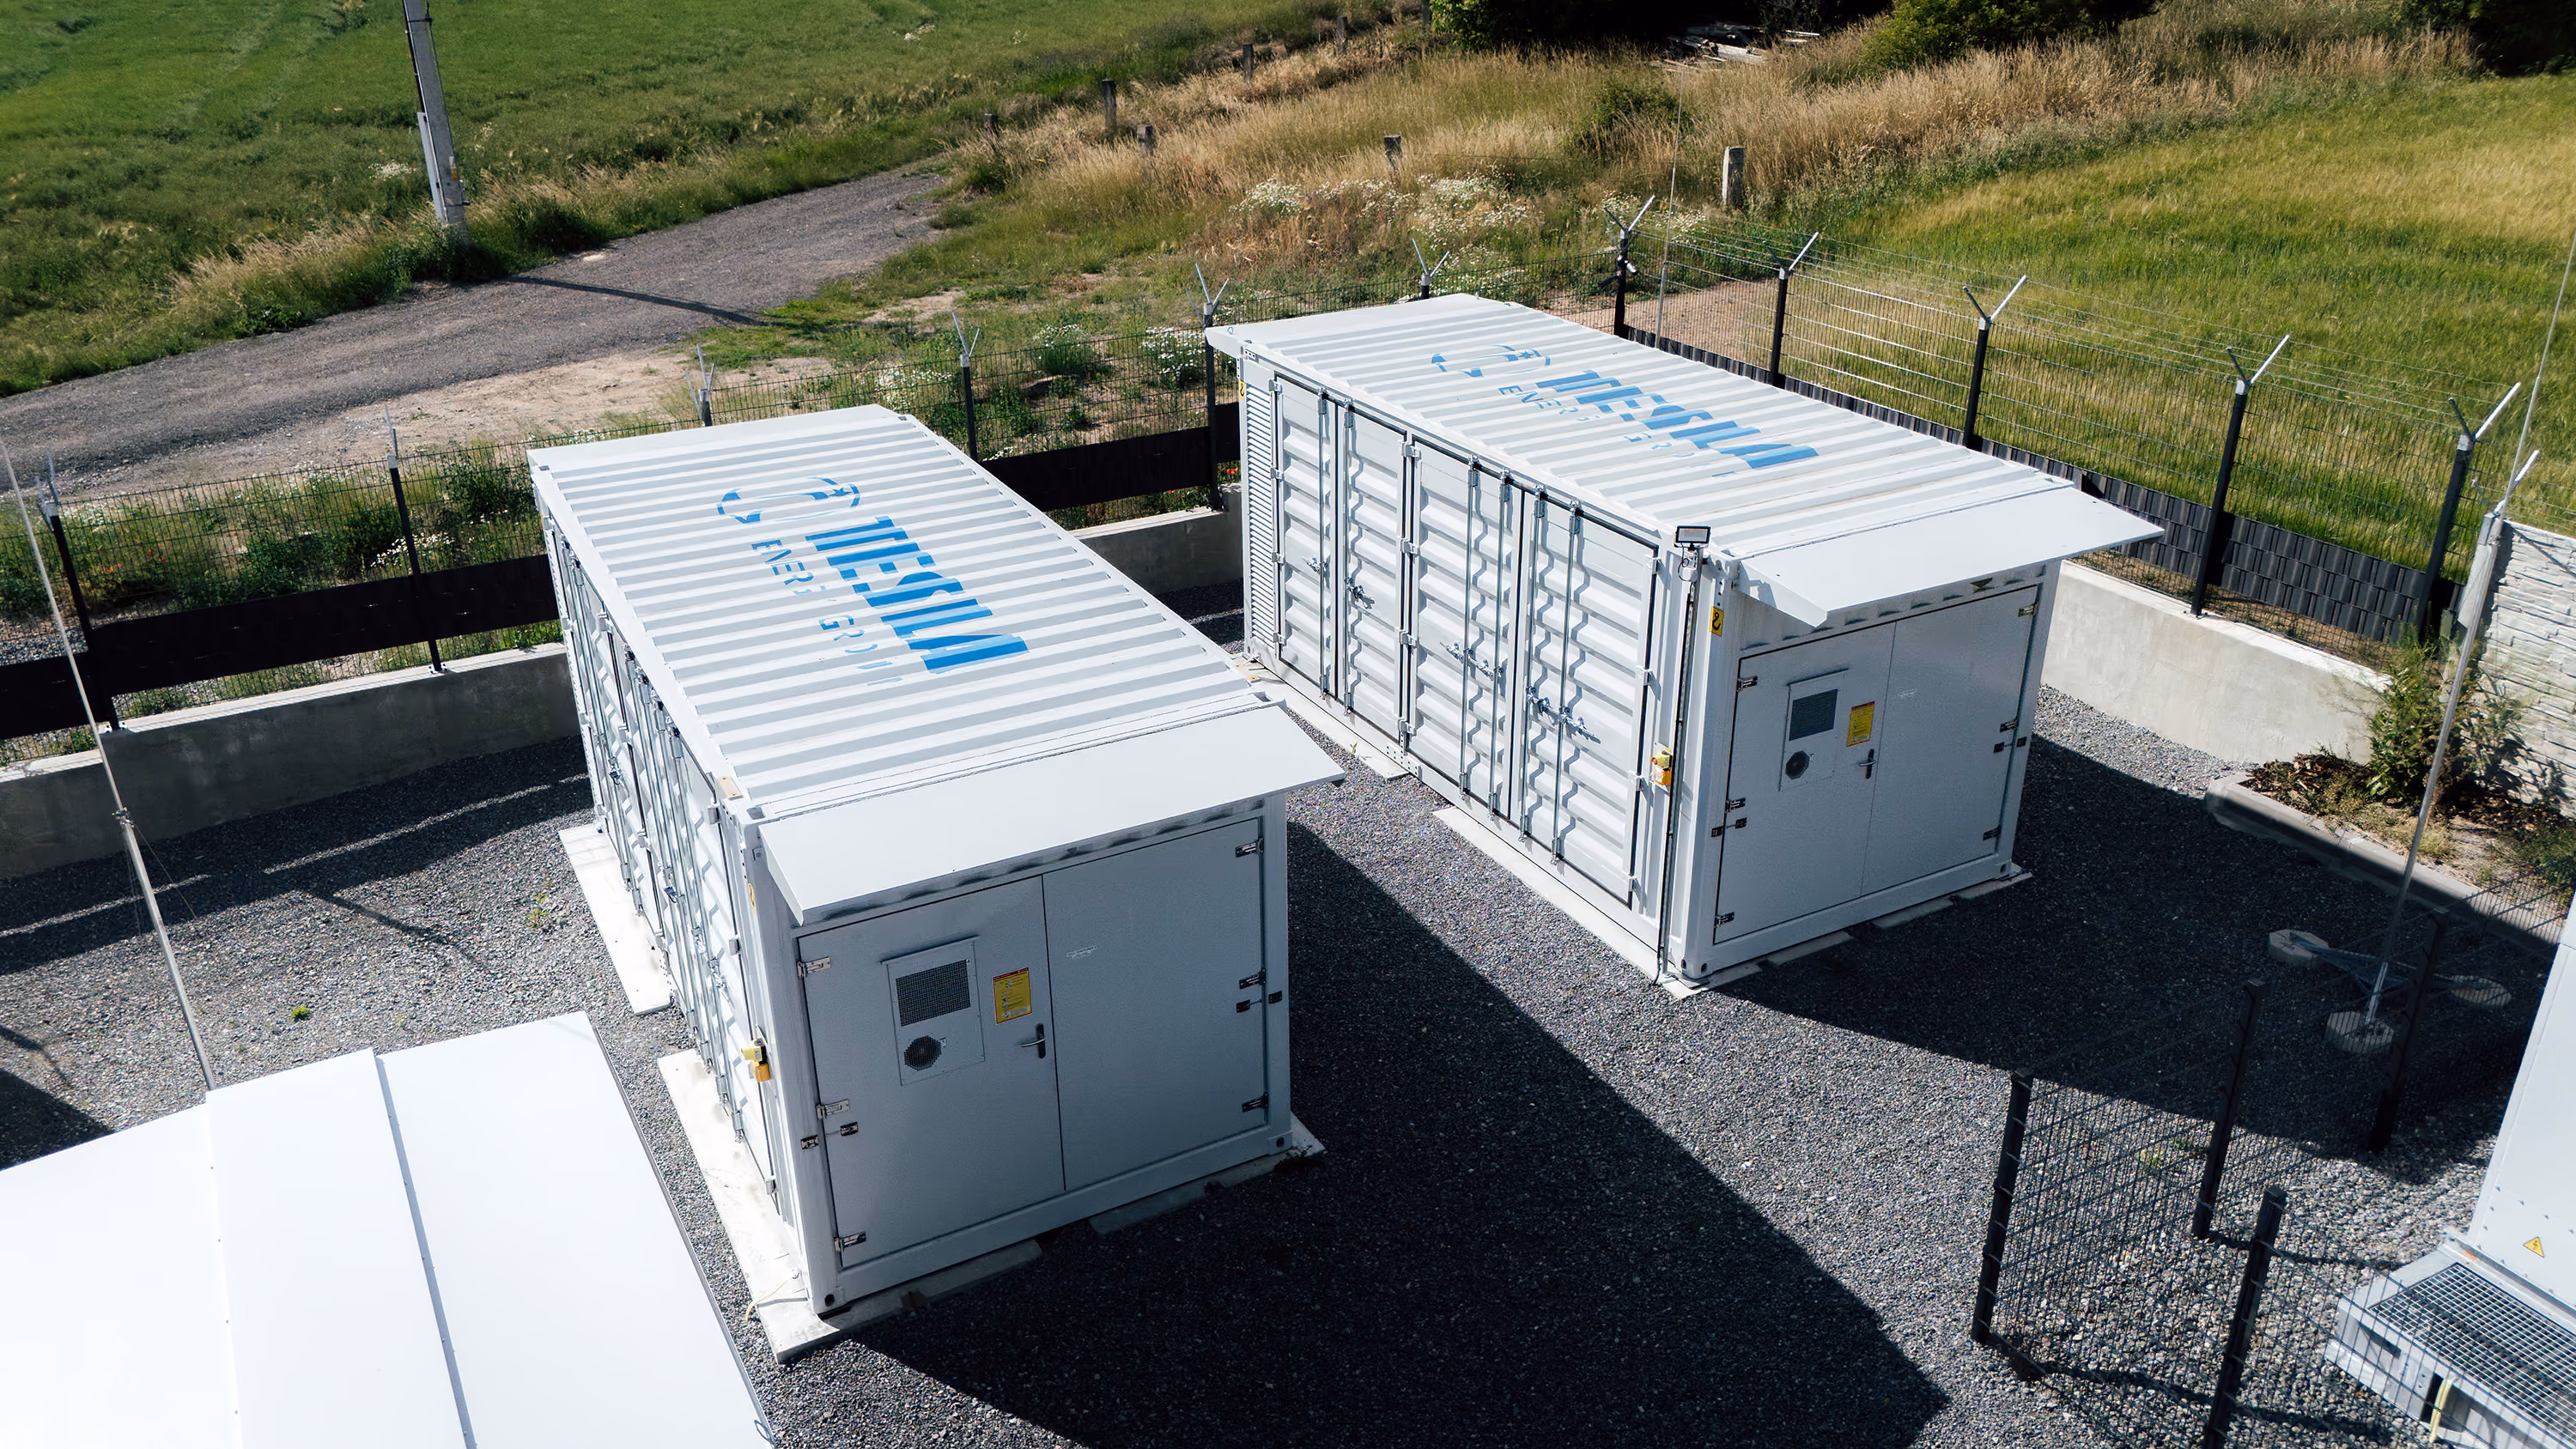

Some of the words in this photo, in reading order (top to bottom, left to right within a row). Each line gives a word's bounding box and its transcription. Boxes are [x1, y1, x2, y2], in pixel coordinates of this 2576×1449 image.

[1536, 369, 1820, 469] TESLA
[751, 538, 838, 602] ENER
[805, 515, 1030, 674] TESLA
